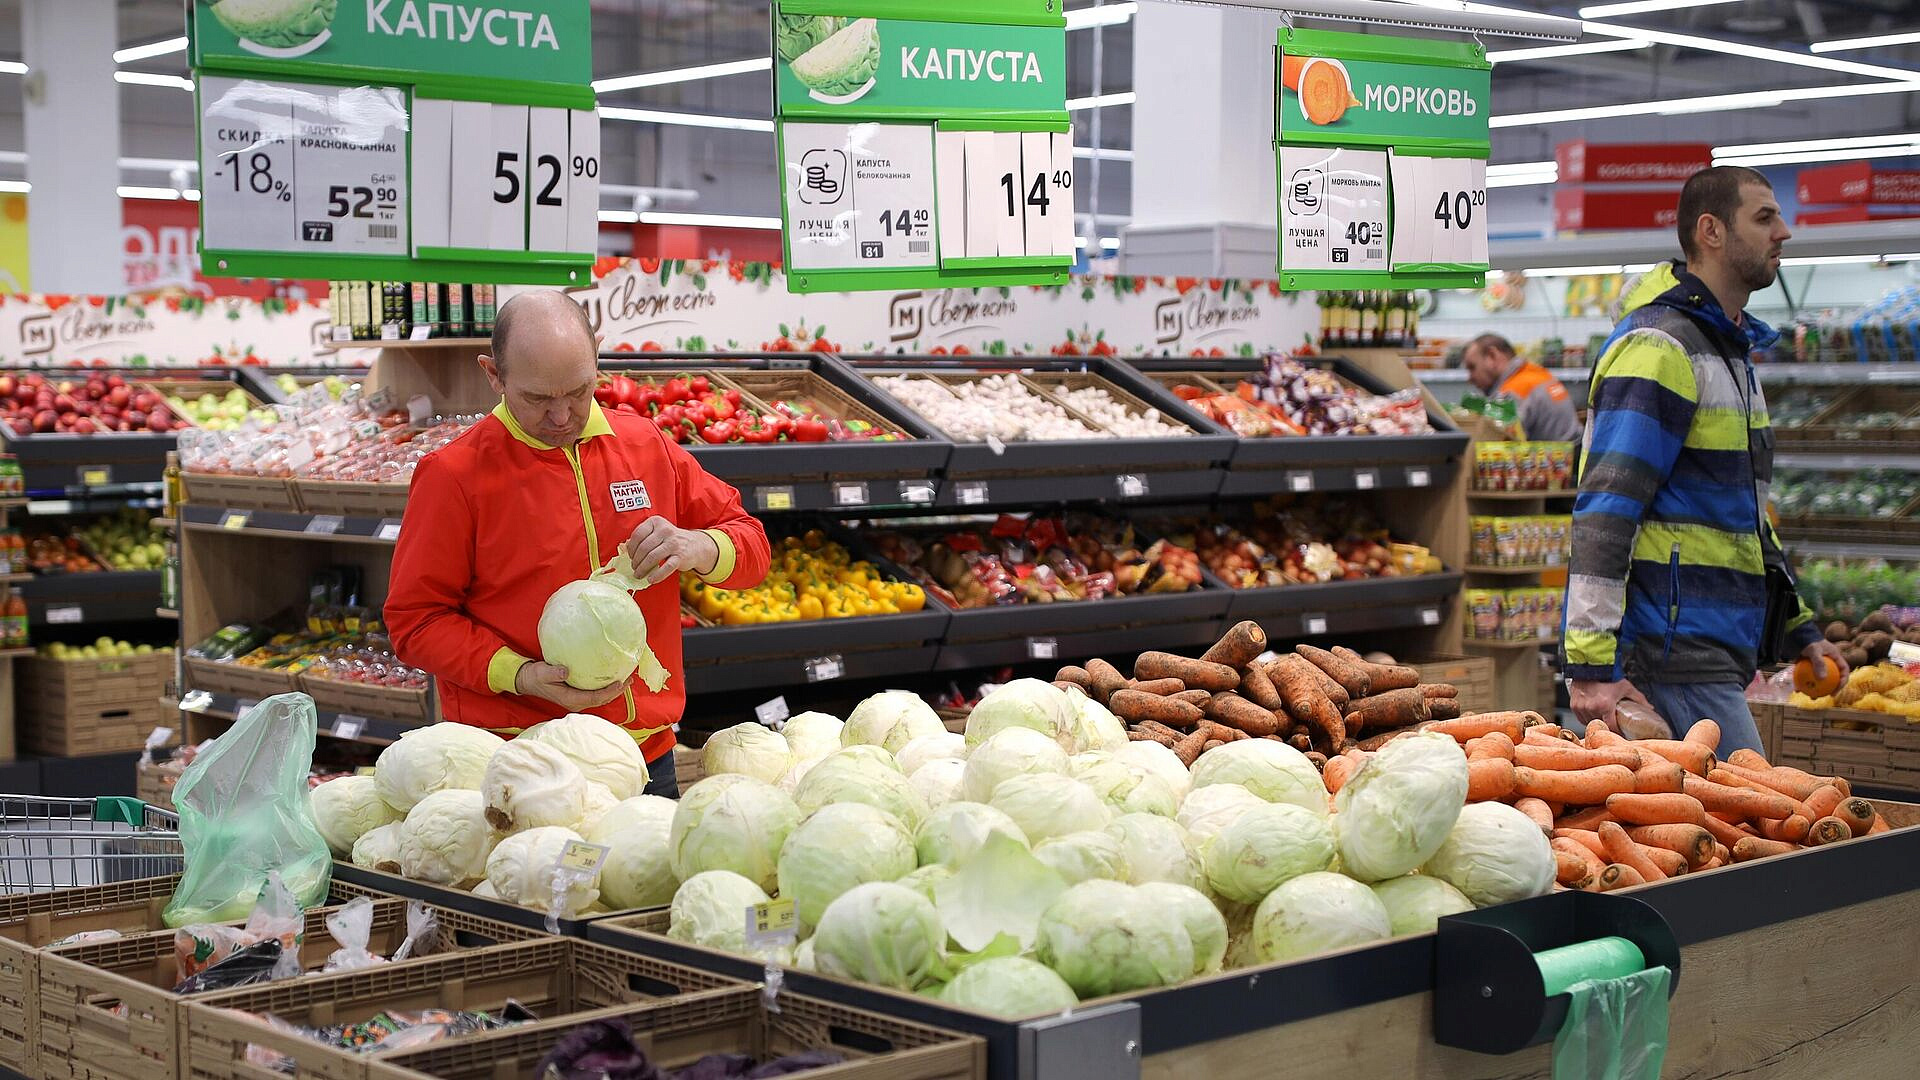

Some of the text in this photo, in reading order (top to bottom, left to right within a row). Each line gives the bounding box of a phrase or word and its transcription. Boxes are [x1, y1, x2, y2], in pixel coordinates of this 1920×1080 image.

[366, 0, 560, 51] КАПУСТА
[900, 46, 1043, 83] КАПУСТА
[1365, 83, 1477, 117] МОРКОВЬ
[218, 128, 285, 145] СКИДА
[856, 159, 891, 168] КАПУСТА
[1331, 178, 1359, 187] МОРКОВЬ
[799, 219, 849, 230] ЛУЧШЯ
[309, 227, 327, 240] 77
[1289, 228, 1325, 238] ЛУЧШАЯ
[1295, 239, 1319, 248] ЦЕНА
[866, 246, 879, 257] 81
[1335, 253, 1345, 262] 91
[608, 274, 716, 320] Свежесть
[613, 486, 645, 497] МАГНИ
